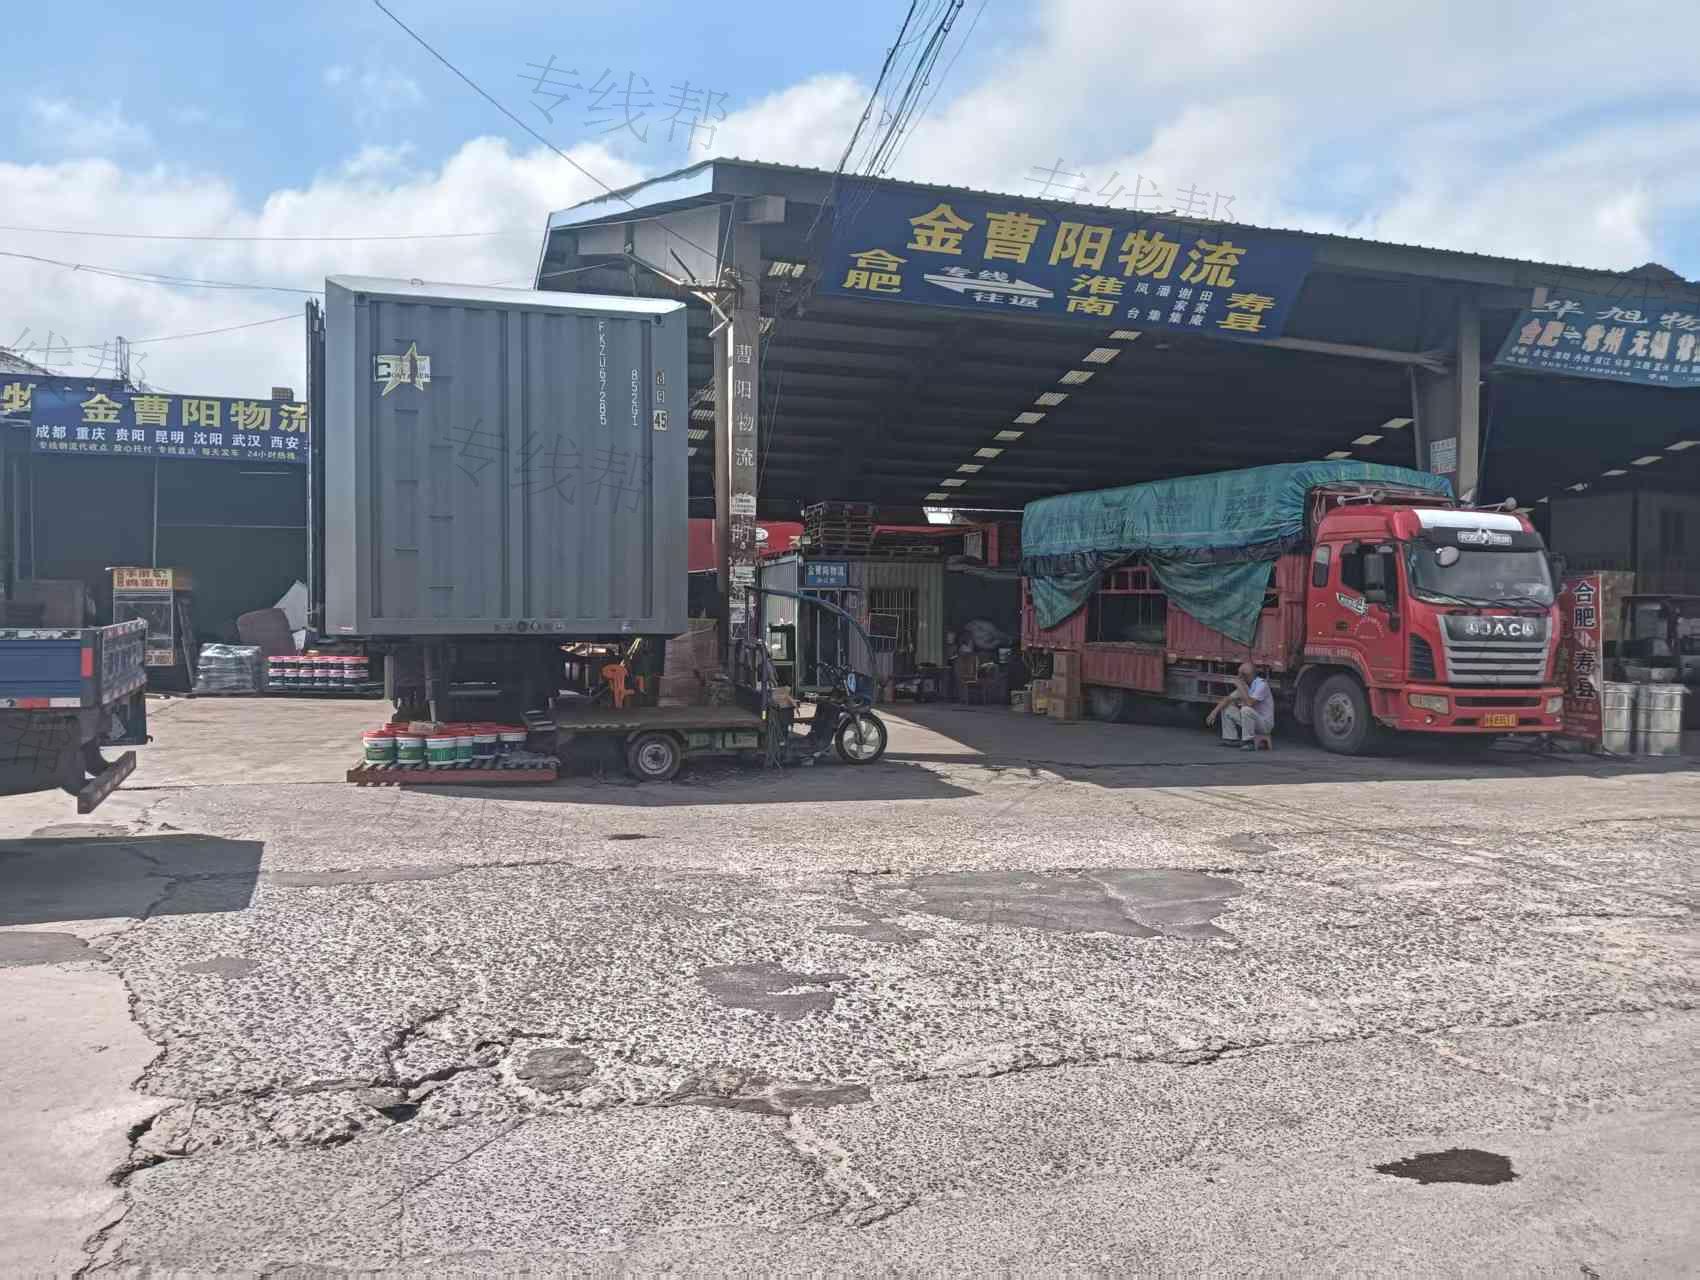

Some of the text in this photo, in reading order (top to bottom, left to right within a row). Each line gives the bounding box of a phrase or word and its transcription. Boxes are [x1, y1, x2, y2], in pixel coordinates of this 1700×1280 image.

[907, 203, 1248, 289] 金曹阳物流
[842, 248, 907, 293] 合肥
[1065, 274, 1129, 317] 淮南
[1216, 293, 1276, 332] 寿县
[35, 425, 299, 450] 成都 重庆 贵阳 昆明 沈阳 武汉 西安
[1573, 580, 1597, 629] 合肥
[1574, 651, 1597, 699] 寿县
